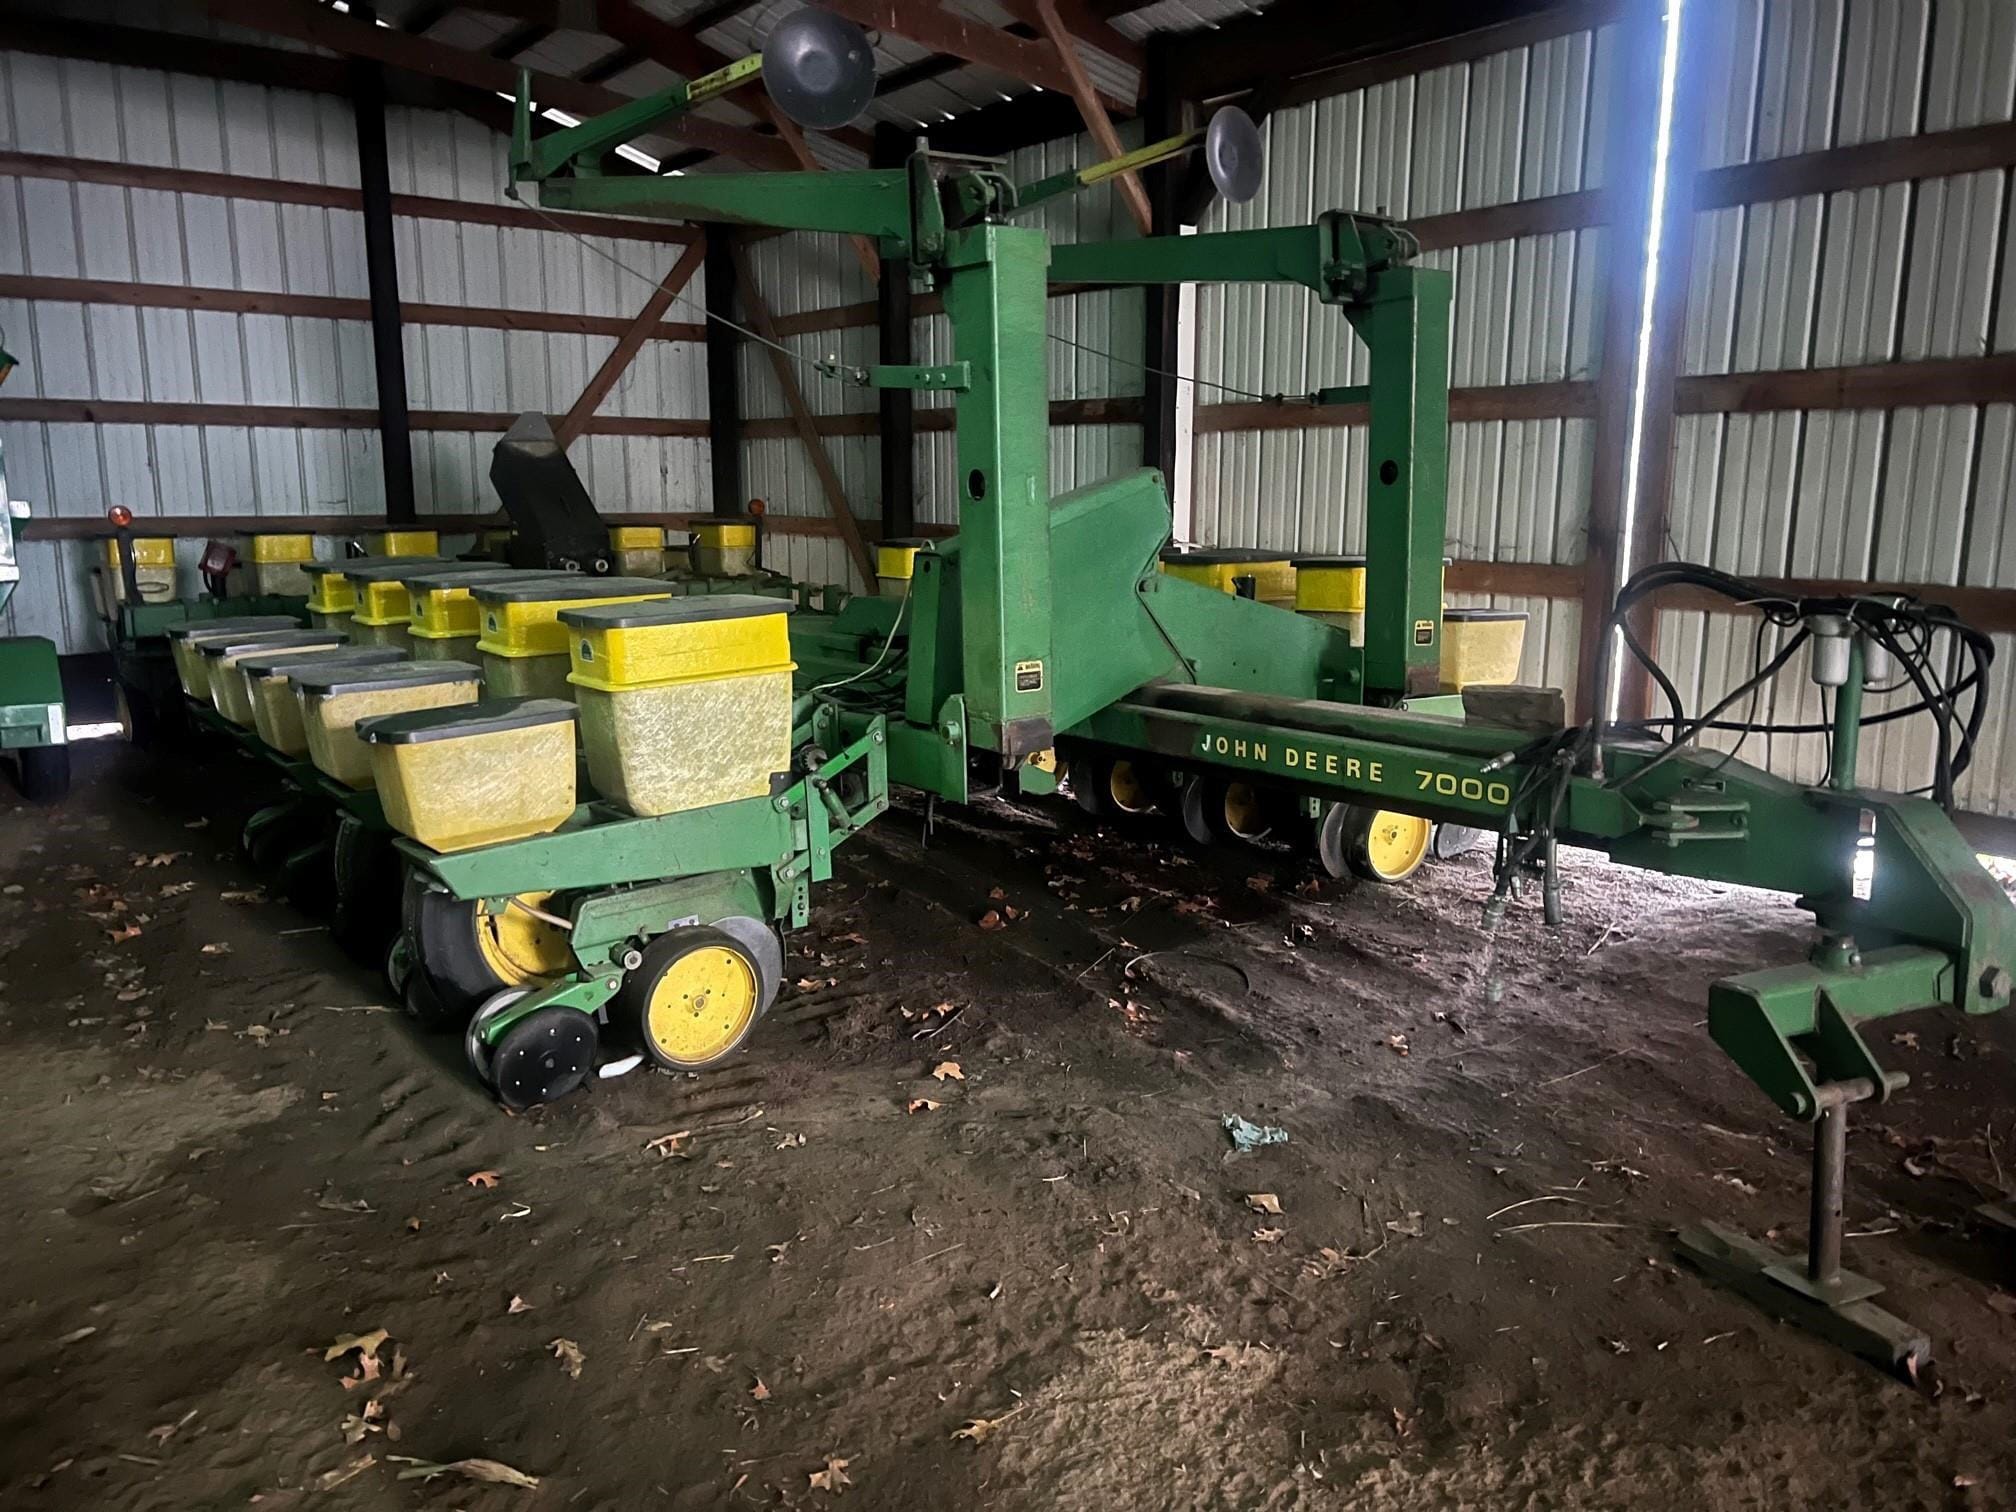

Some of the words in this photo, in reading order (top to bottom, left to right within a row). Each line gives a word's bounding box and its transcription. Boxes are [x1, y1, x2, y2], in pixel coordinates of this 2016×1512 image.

[1201, 734, 1267, 762] JOHN
[1285, 748, 1383, 783] DEERE
[1415, 769, 1510, 806] 7000
